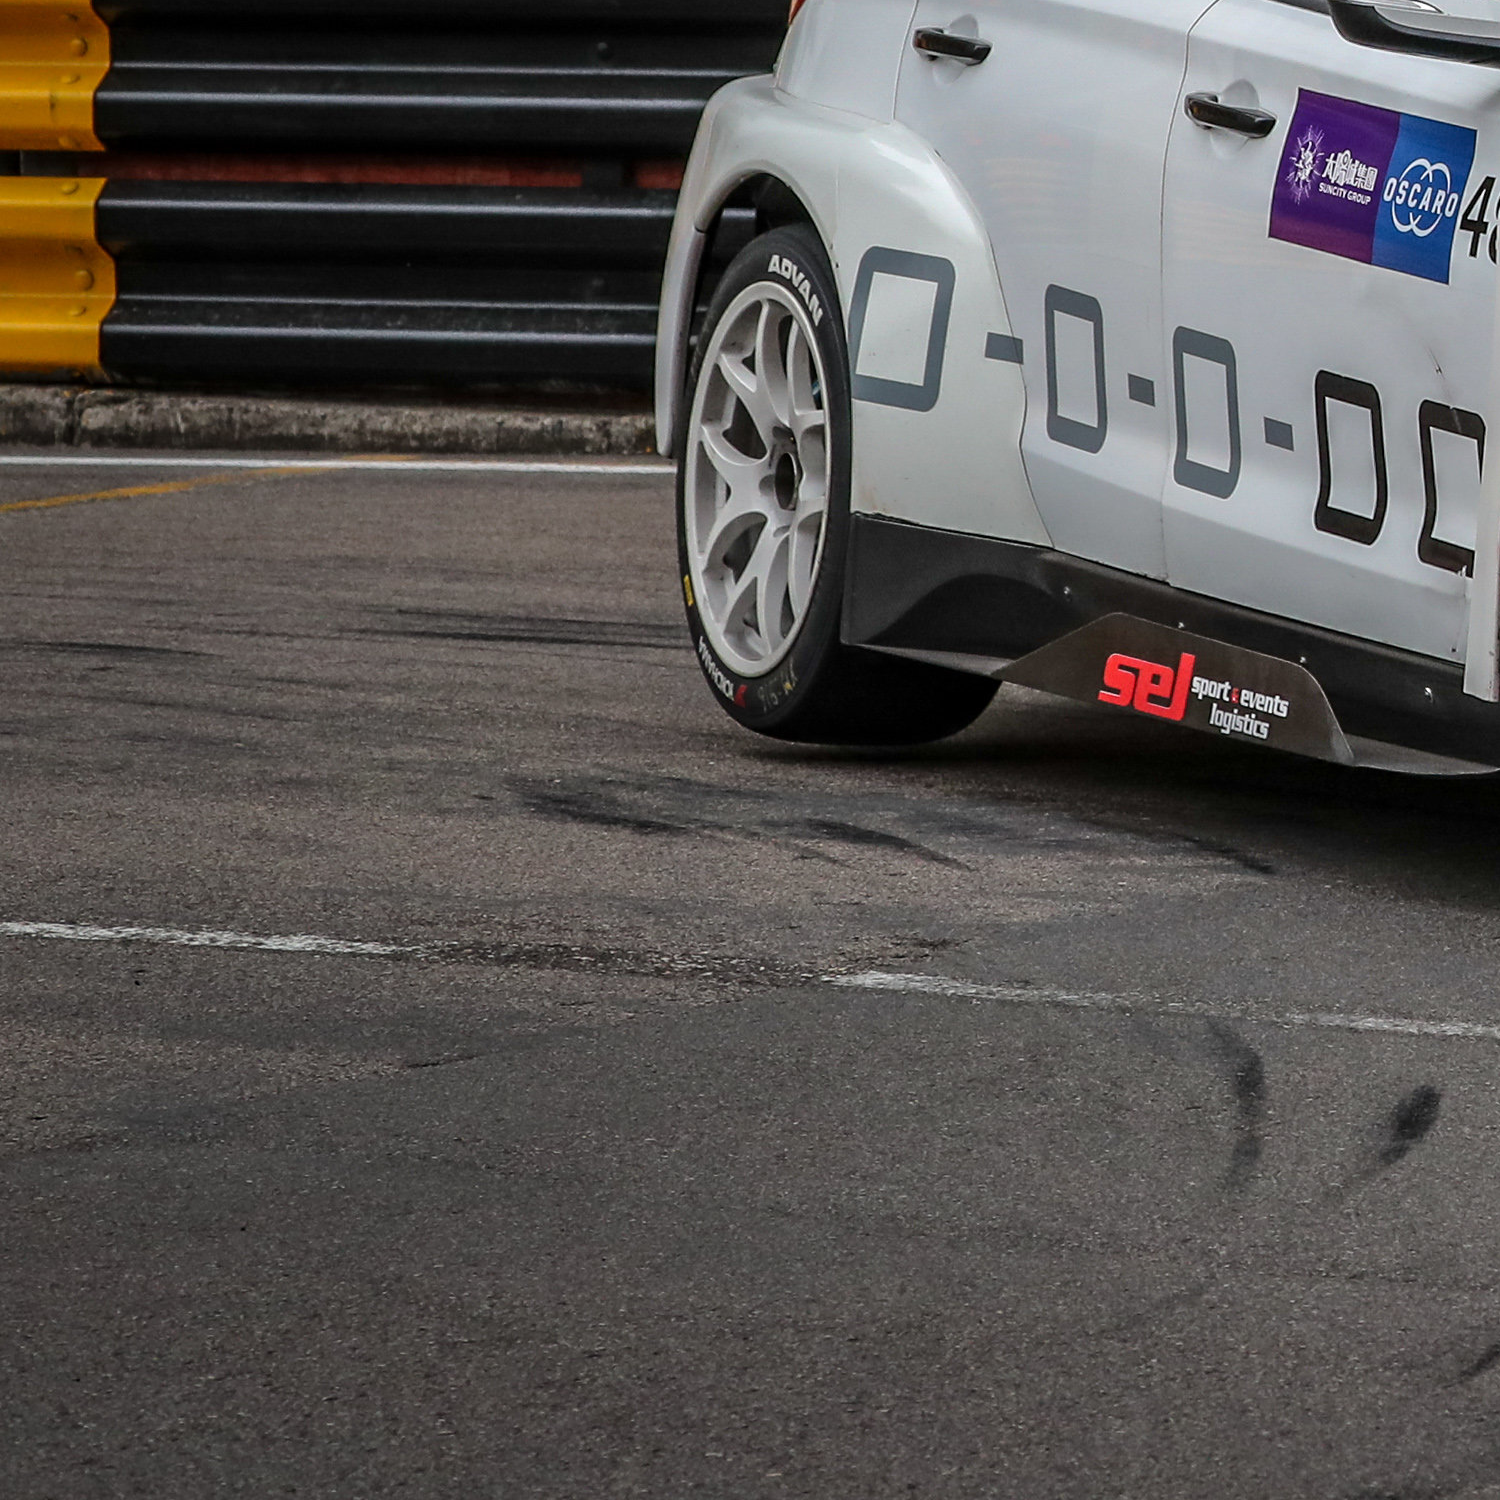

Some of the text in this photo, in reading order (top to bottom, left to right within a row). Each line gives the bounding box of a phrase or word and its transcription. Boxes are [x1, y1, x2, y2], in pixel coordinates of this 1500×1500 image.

[1318, 182, 1372, 206] SUNCITY GROUP
[1383, 176, 1459, 219] OSCARO
[767, 253, 824, 328] ADVAN
[1097, 652, 1196, 722] sel
[1190, 675, 1232, 702] sport
[1239, 688, 1290, 719] events
[1209, 702, 1271, 741] logistics
